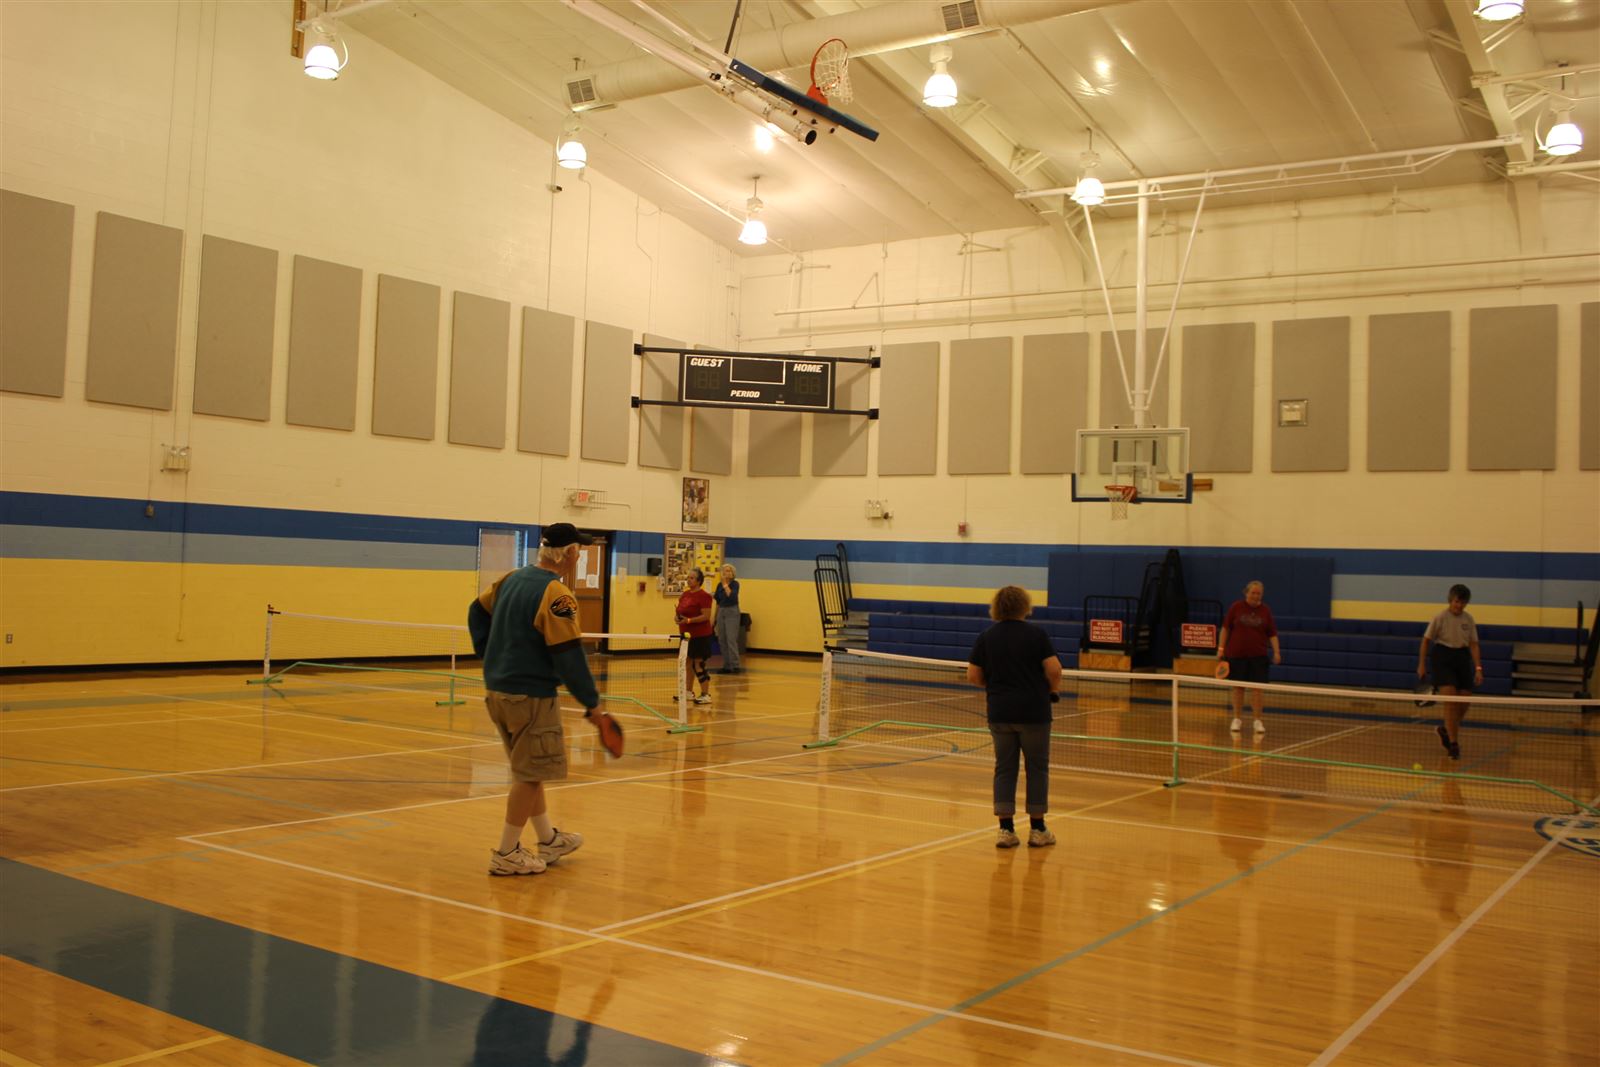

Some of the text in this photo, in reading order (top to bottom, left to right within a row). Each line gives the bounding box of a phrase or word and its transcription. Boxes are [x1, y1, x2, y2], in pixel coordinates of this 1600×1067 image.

[690, 357, 724, 368] GUEST
[793, 363, 823, 373] HOME
[730, 389, 760, 398] PERIOD
